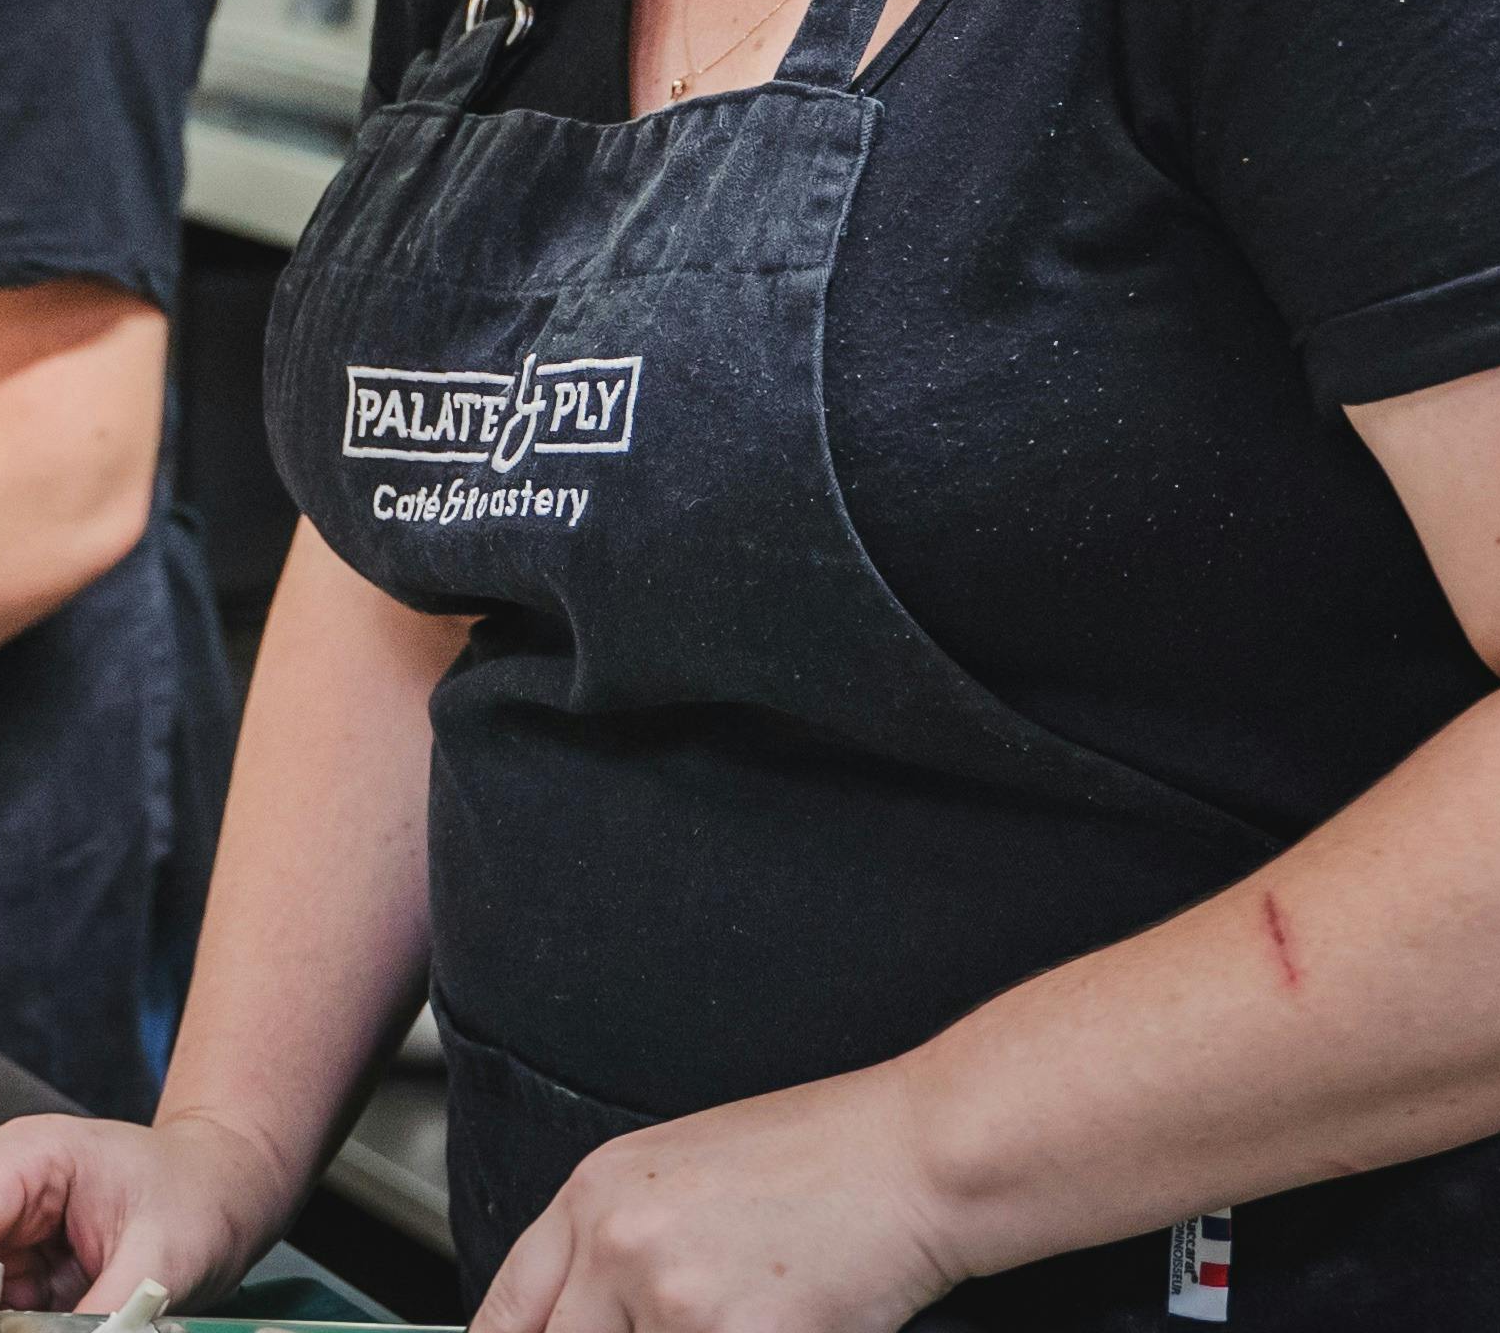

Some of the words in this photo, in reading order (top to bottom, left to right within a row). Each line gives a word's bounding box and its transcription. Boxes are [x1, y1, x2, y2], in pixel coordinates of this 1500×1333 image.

[356, 388, 508, 443] PALATE
[549, 379, 625, 432] PLY
[1171, 1221, 1186, 1296] ONNOISSEUR
